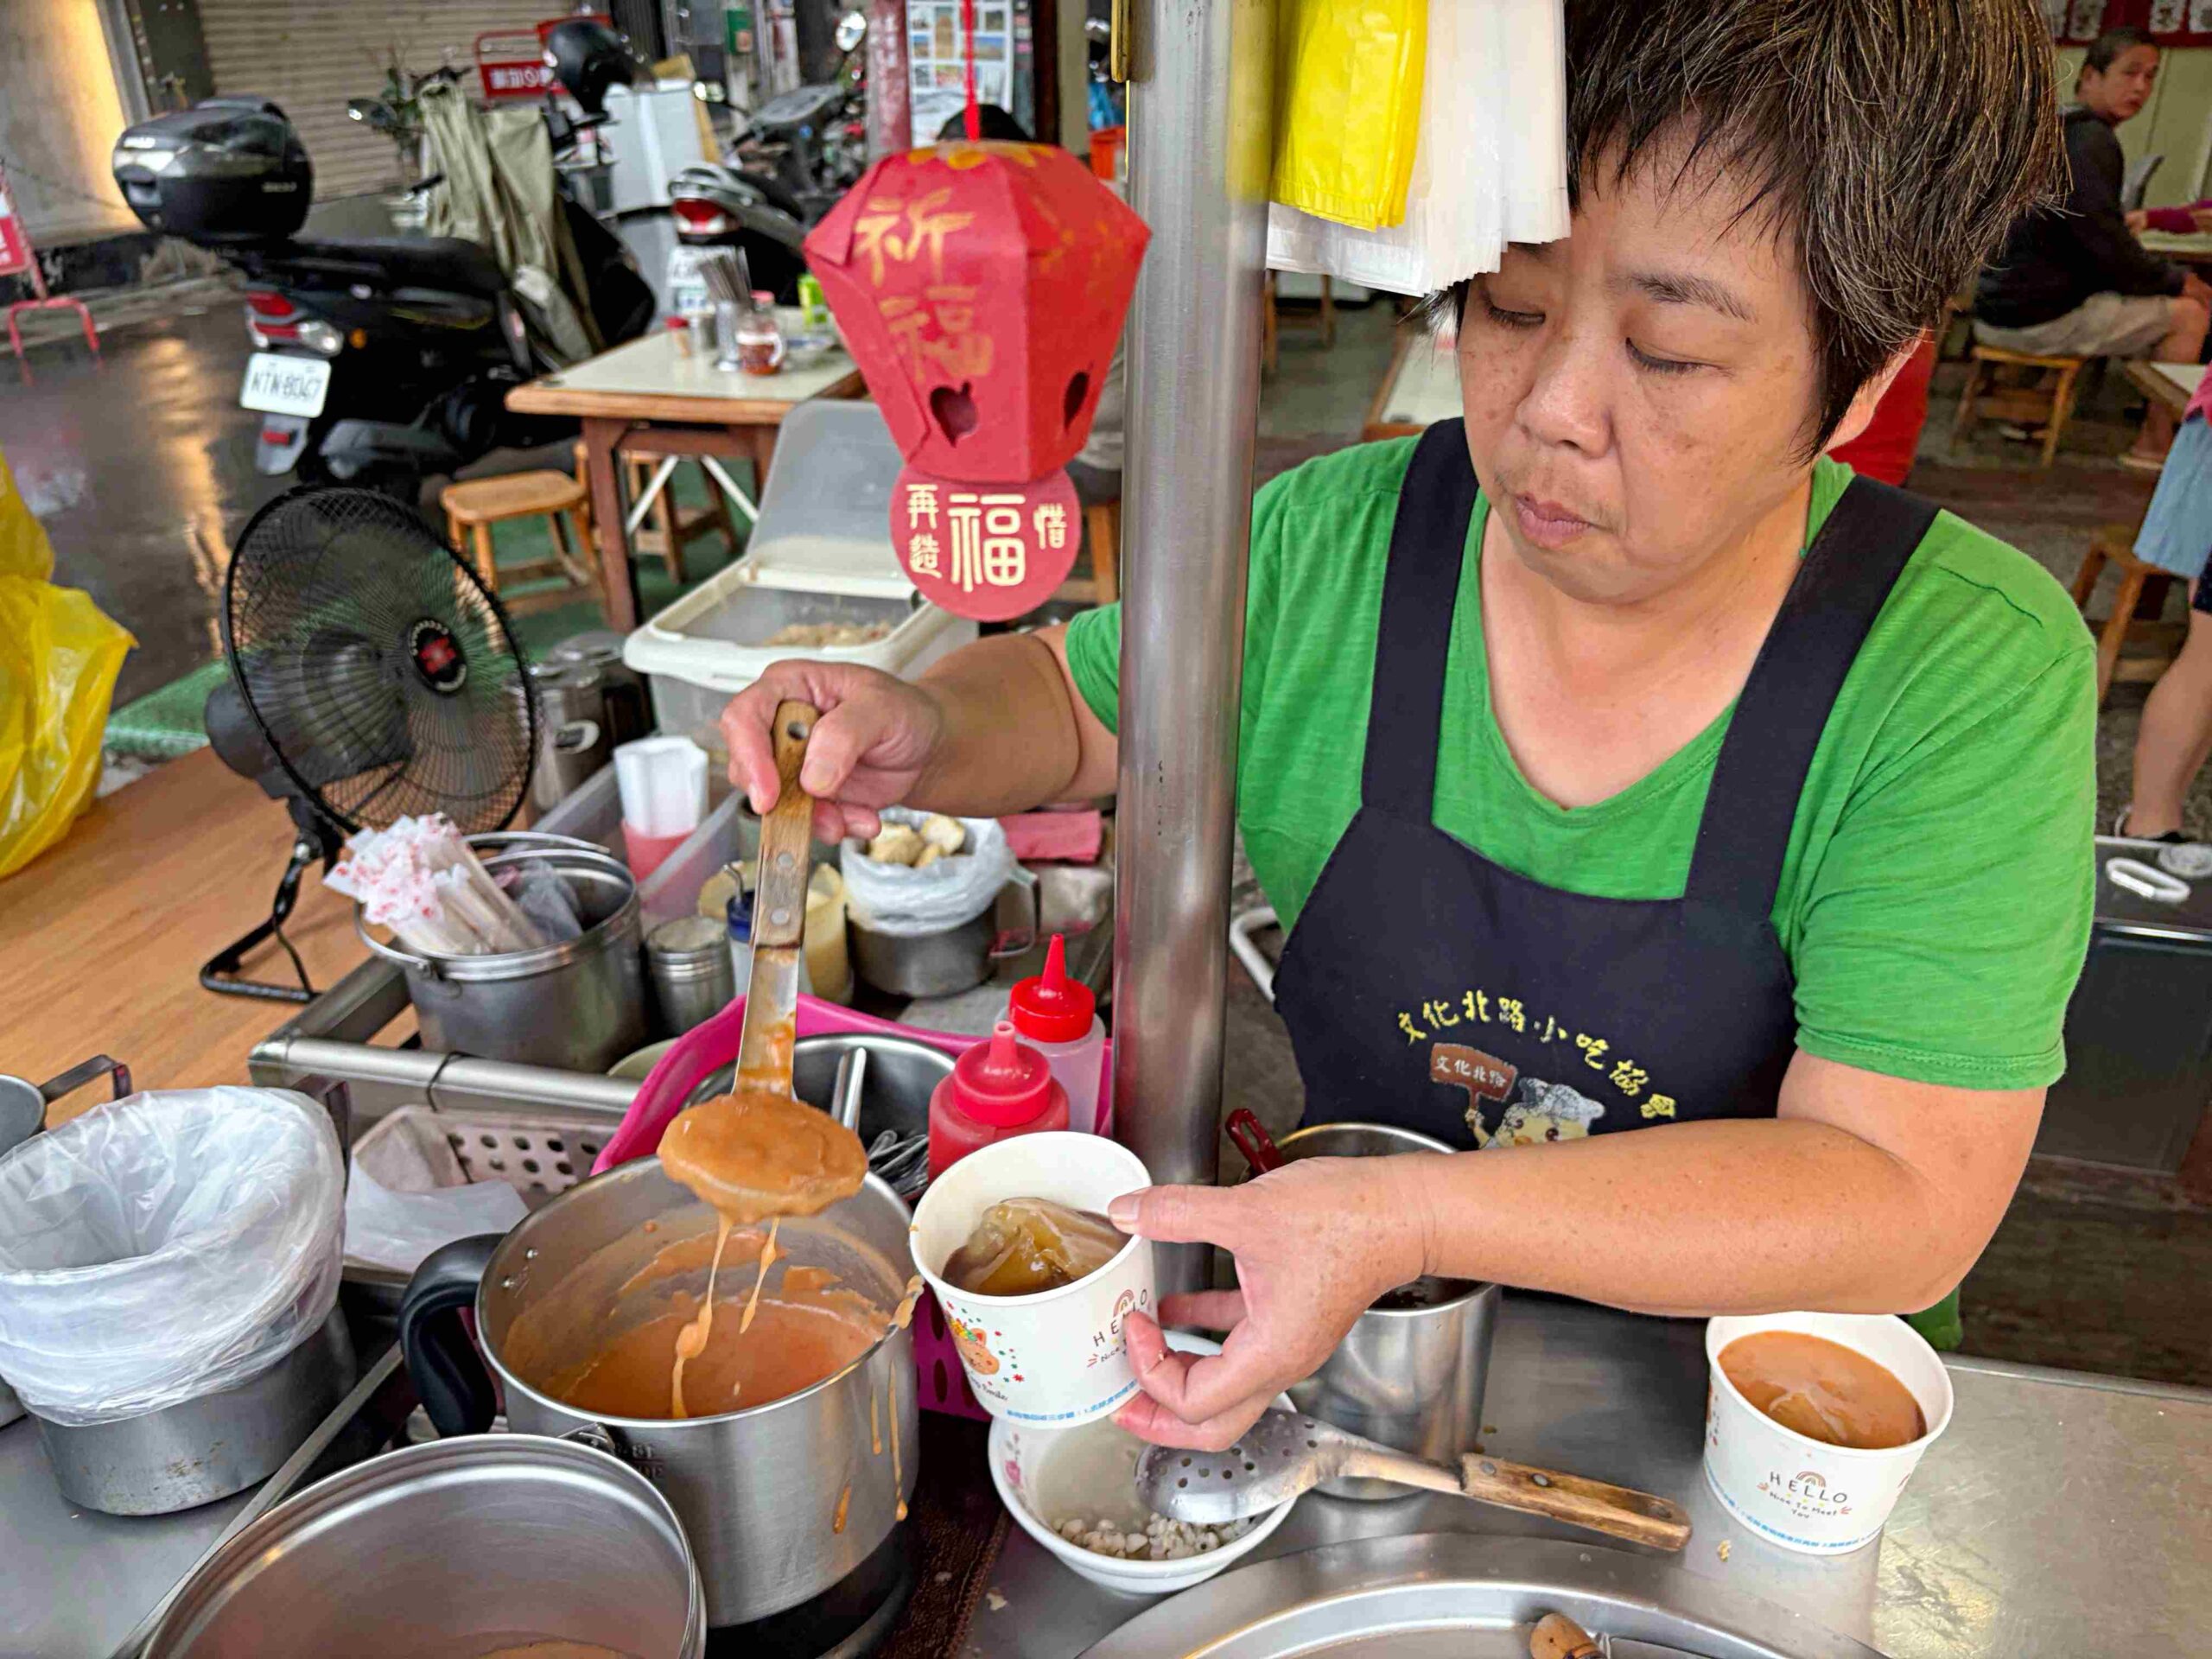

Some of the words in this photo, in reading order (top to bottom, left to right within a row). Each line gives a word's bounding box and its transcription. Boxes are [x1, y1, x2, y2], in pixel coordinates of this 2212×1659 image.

[854, 188, 995, 381] 祈福
[947, 493, 1027, 593] 福
[1434, 1055, 1508, 1089] 文化北路
[1769, 1471, 1848, 1503] HELLO
